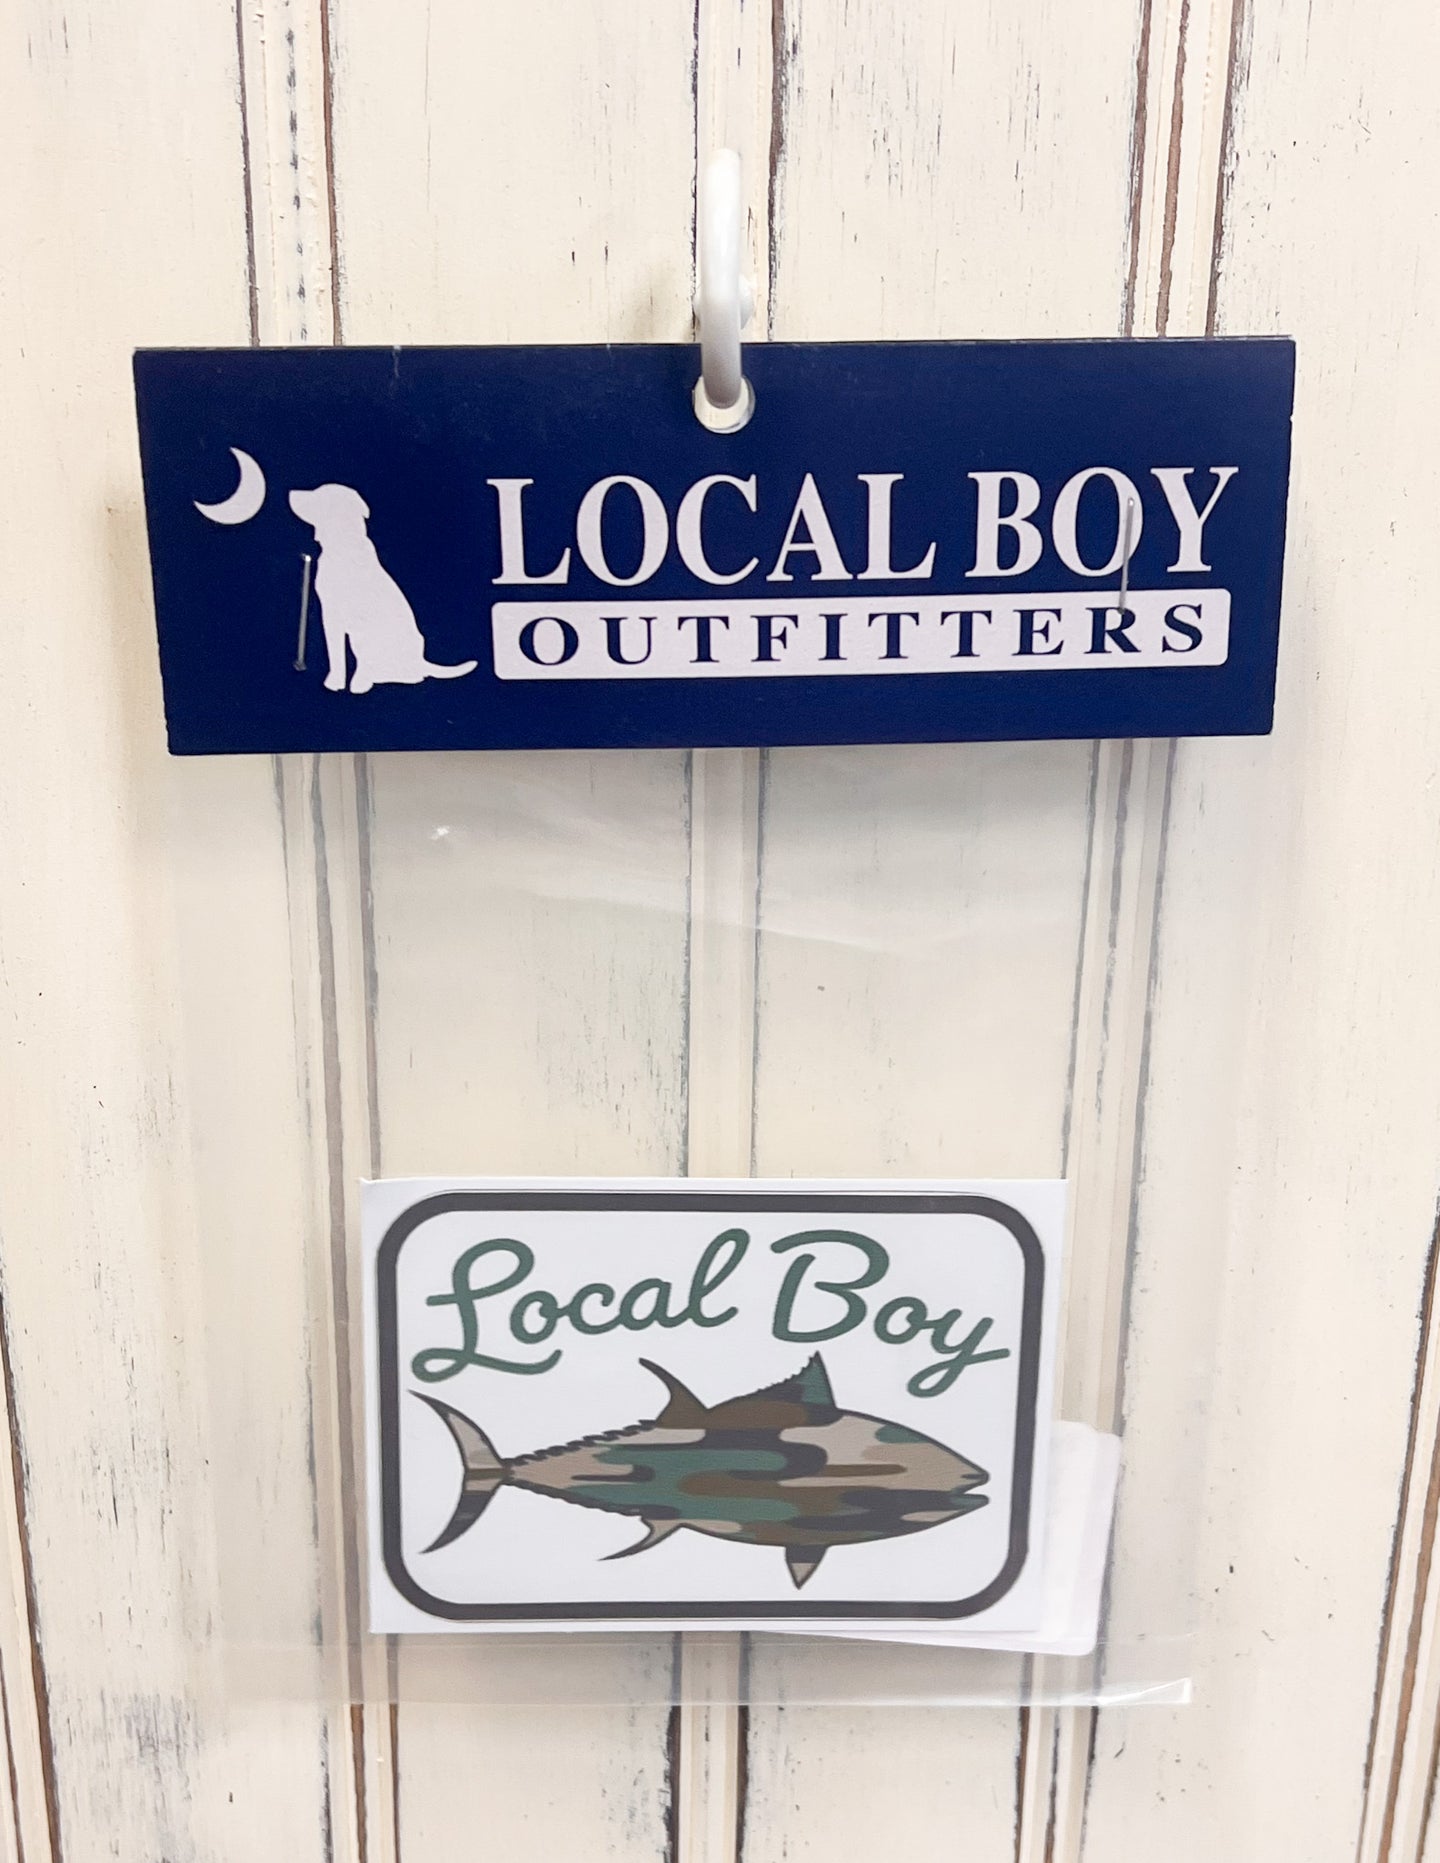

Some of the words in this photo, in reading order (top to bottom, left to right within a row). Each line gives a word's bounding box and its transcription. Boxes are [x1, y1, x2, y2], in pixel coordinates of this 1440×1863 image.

[487, 473, 937, 587] LOCAL
[965, 466, 1239, 578] BOY
[518, 603, 1204, 666] OUTFITTERS
[411, 1228, 750, 1383] Local
[770, 1229, 1010, 1398] Boy
